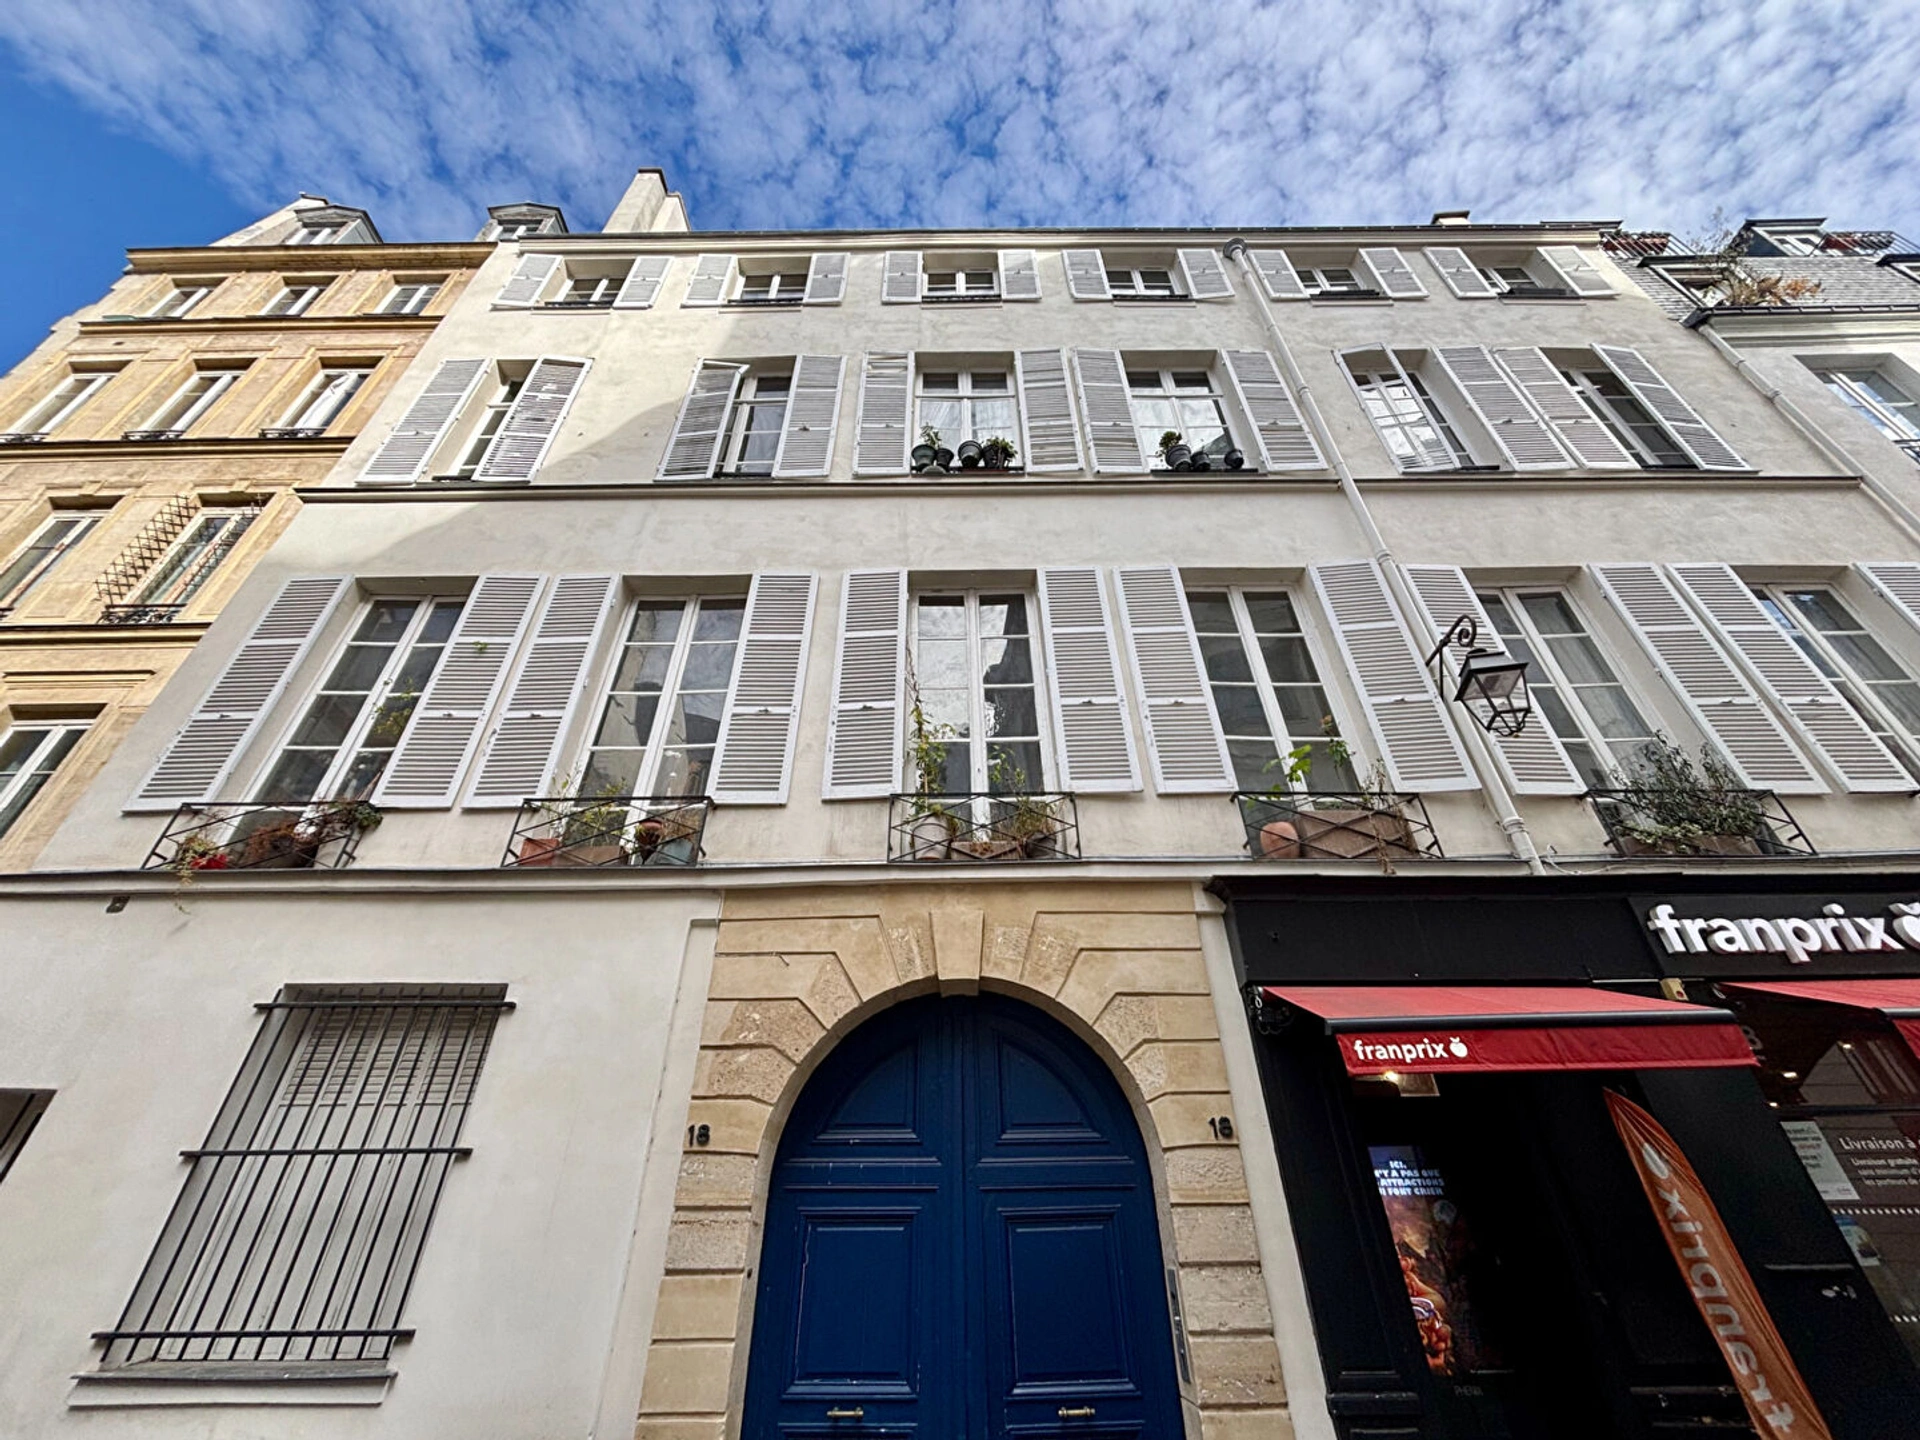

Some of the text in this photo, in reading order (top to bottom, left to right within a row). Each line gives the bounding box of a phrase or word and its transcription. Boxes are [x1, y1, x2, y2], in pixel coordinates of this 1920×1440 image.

[1647, 903, 1905, 963] franprix
[1354, 1037, 1449, 1063] franprix
[688, 1124, 710, 1148] 18
[1208, 1115, 1234, 1140] 18
[1839, 1137, 1905, 1150] Livraison
[1905, 1136, 1917, 1150] à
[1400, 1169, 1419, 1177] PAS
[1387, 1187, 1412, 1195] FONT
